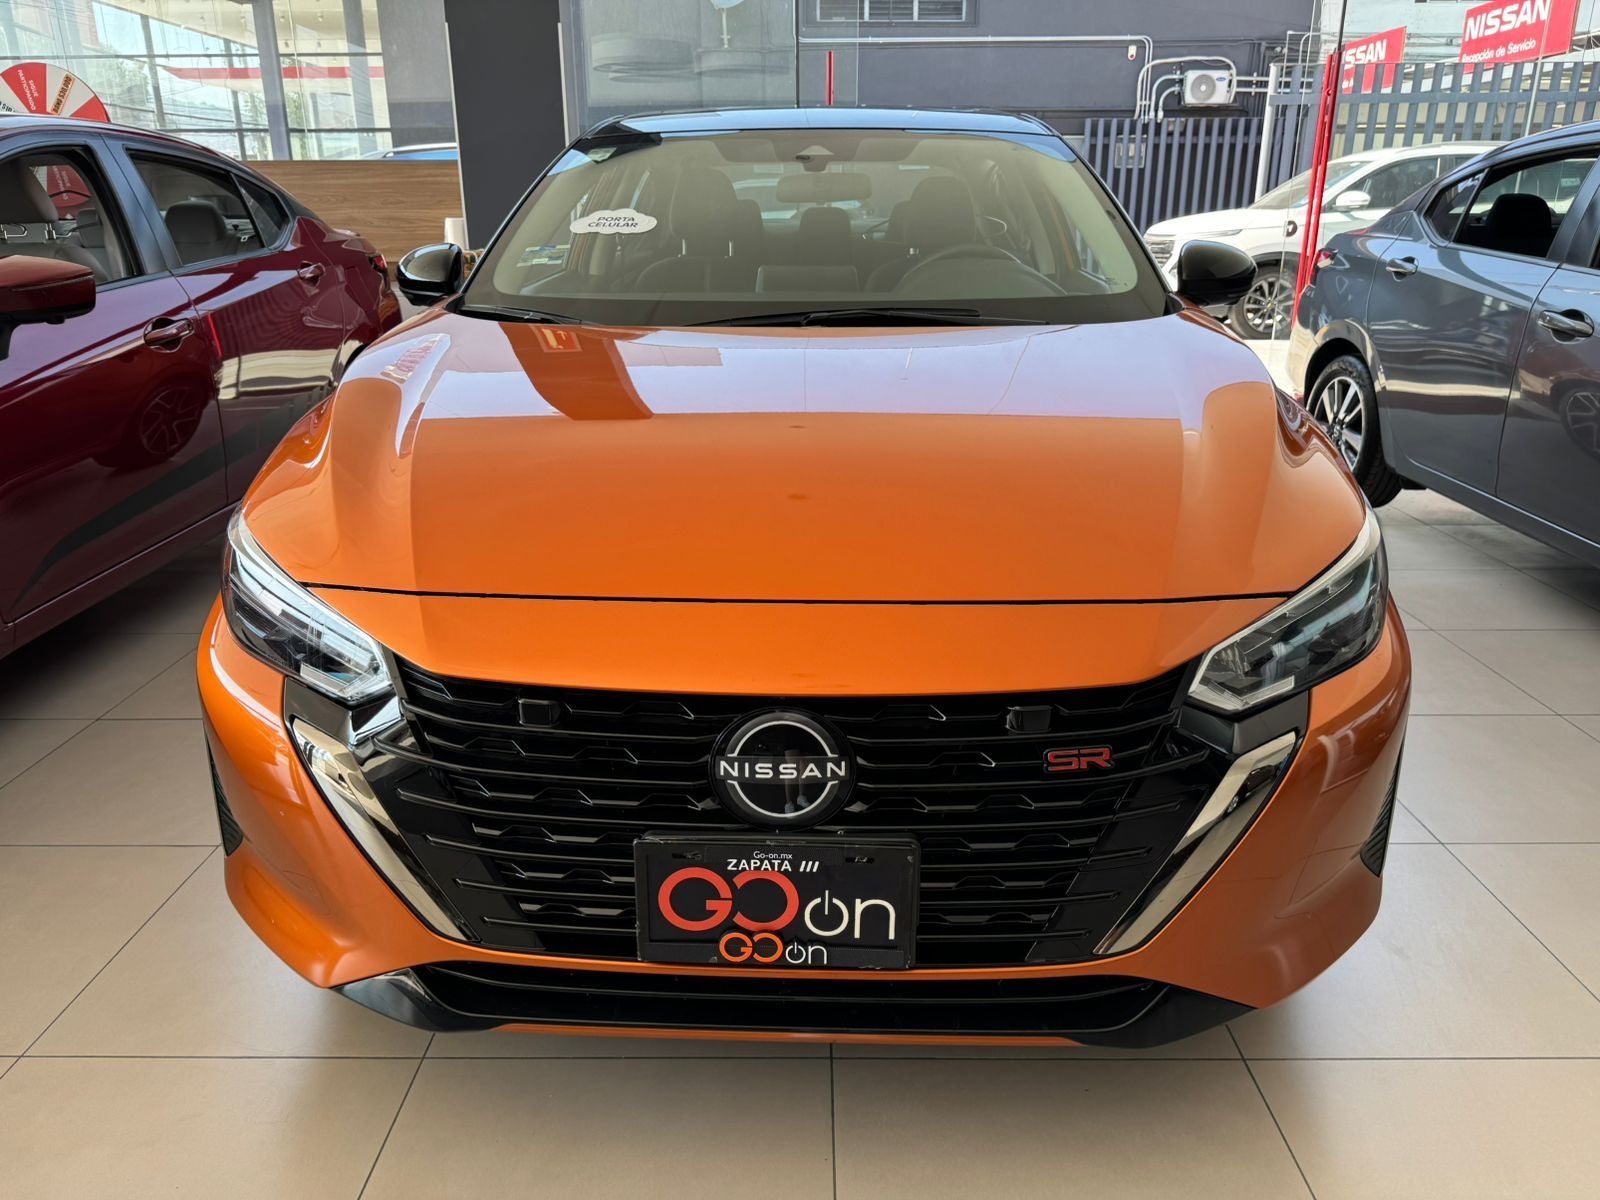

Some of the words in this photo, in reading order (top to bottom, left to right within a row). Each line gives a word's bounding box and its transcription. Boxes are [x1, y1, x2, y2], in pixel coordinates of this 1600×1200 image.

[1465, 0, 1549, 42] NISSAN
[1341, 39, 1387, 70] ISSAN
[1495, 46, 1506, 57] de
[1507, 38, 1536, 54] Servicio
[17, 69, 36, 111] PARTICIPANDO
[28, 79, 39, 97] SIGUE
[1046, 746, 1113, 772] SR
[720, 760, 846, 780] NISSAN
[753, 850, 793, 859] Go-on.mx
[727, 859, 792, 872] ZAPATA
